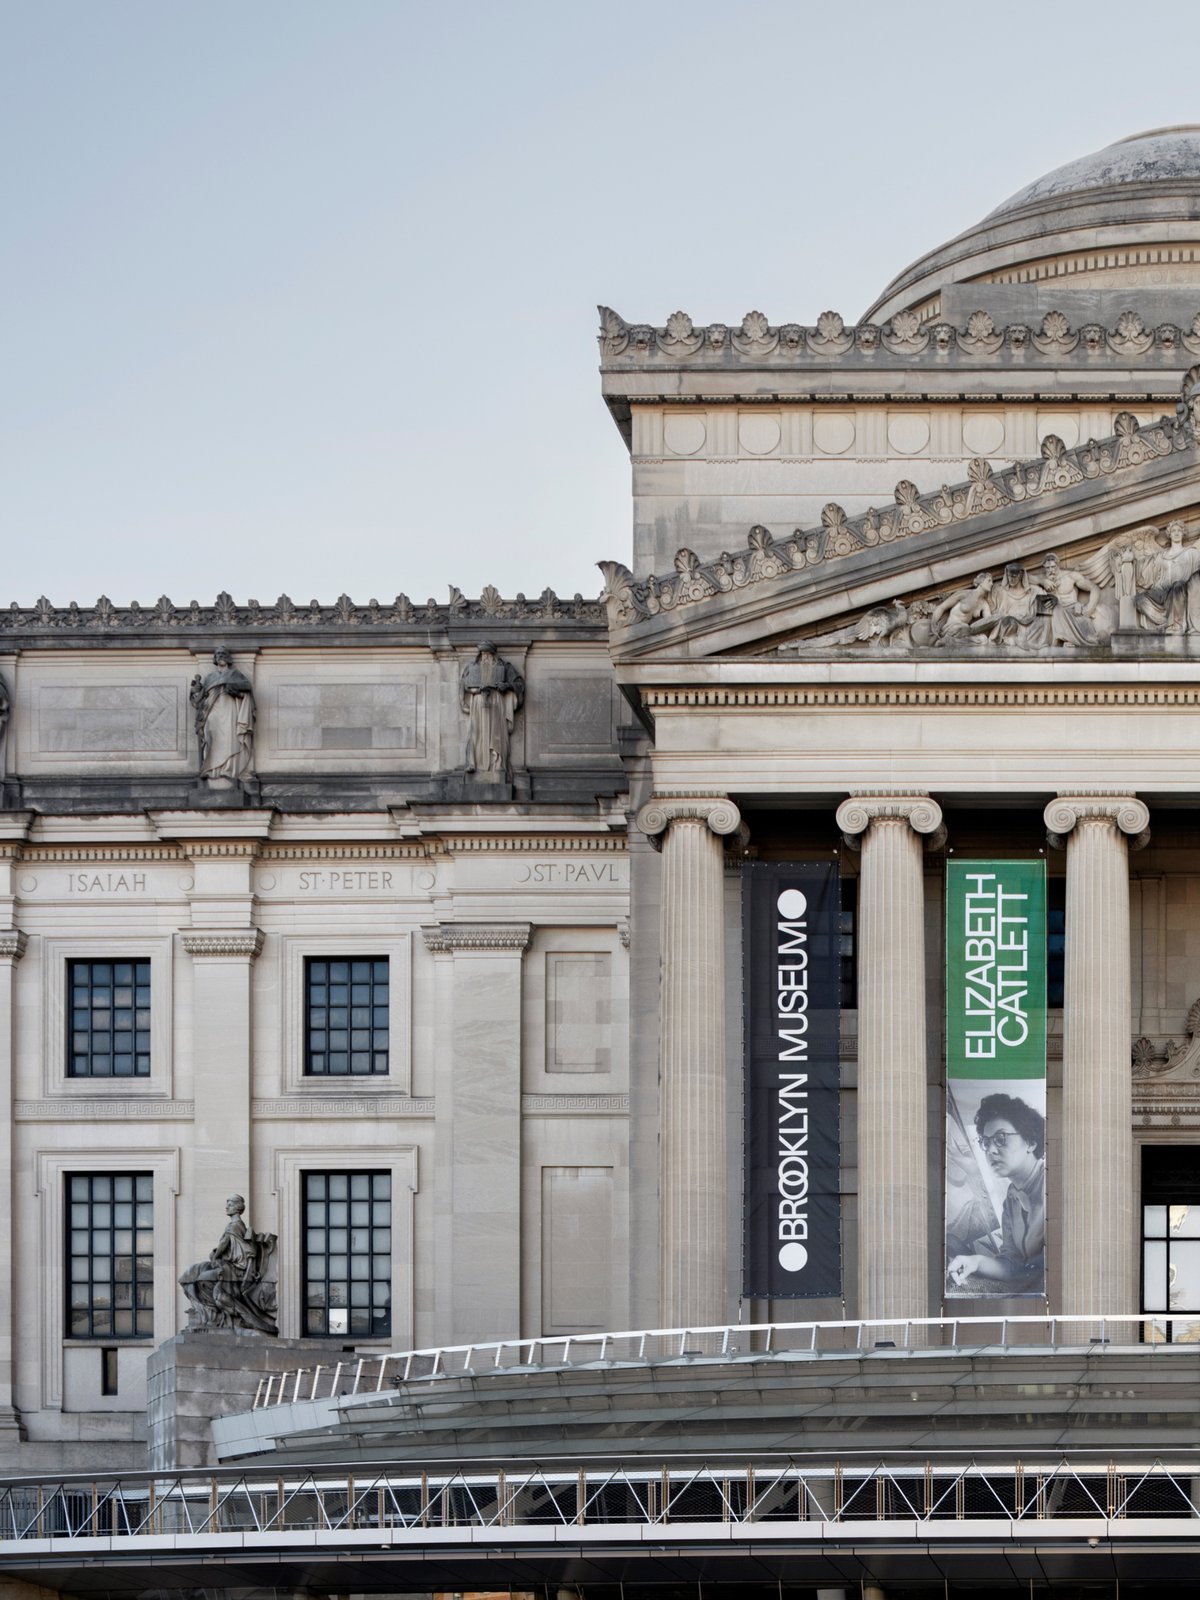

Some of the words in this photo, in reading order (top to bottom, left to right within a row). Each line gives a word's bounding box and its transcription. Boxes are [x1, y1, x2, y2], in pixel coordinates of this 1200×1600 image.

[68, 873, 147, 892] ISAIAH
[778, 921, 808, 1061] MUSEUM
[965, 873, 996, 1058] ELIZABETH
[997, 884, 1028, 1047] CATLETT
[779, 1074, 808, 1240] BROOKLYN
